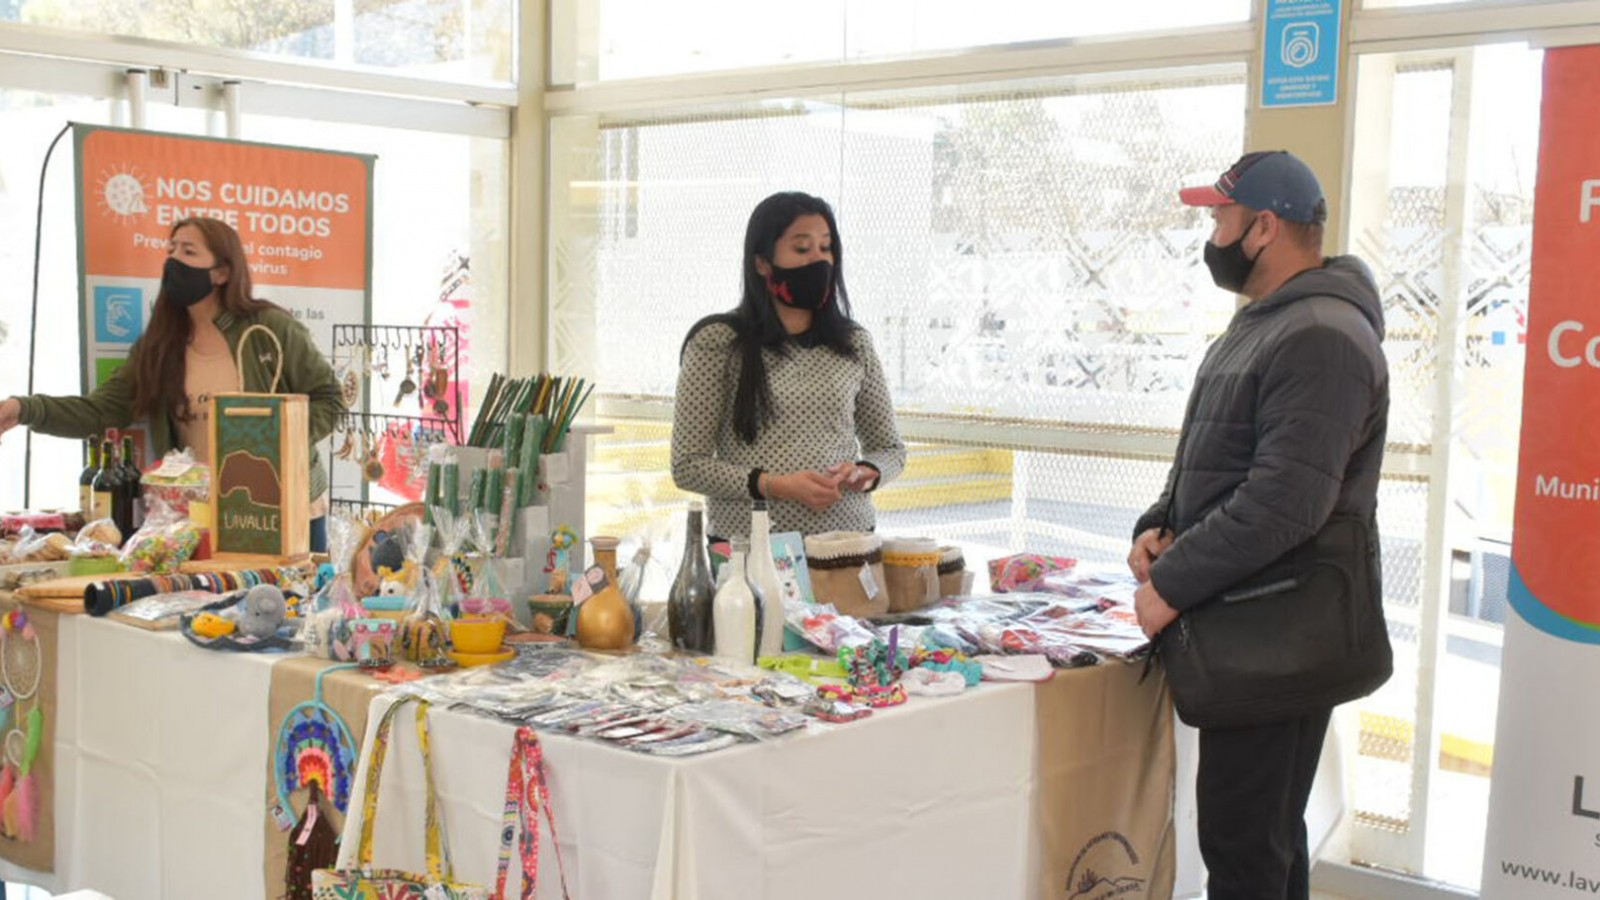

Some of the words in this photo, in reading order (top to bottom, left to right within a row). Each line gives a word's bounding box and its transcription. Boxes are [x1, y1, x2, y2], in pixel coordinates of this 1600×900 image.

[157, 178, 212, 201] NOS
[220, 183, 349, 213] CUIDAMOS
[246, 212, 331, 237] TODOS
[258, 244, 323, 261] contagio
[306, 308, 324, 320] las
[225, 512, 279, 532] LAVALLE
